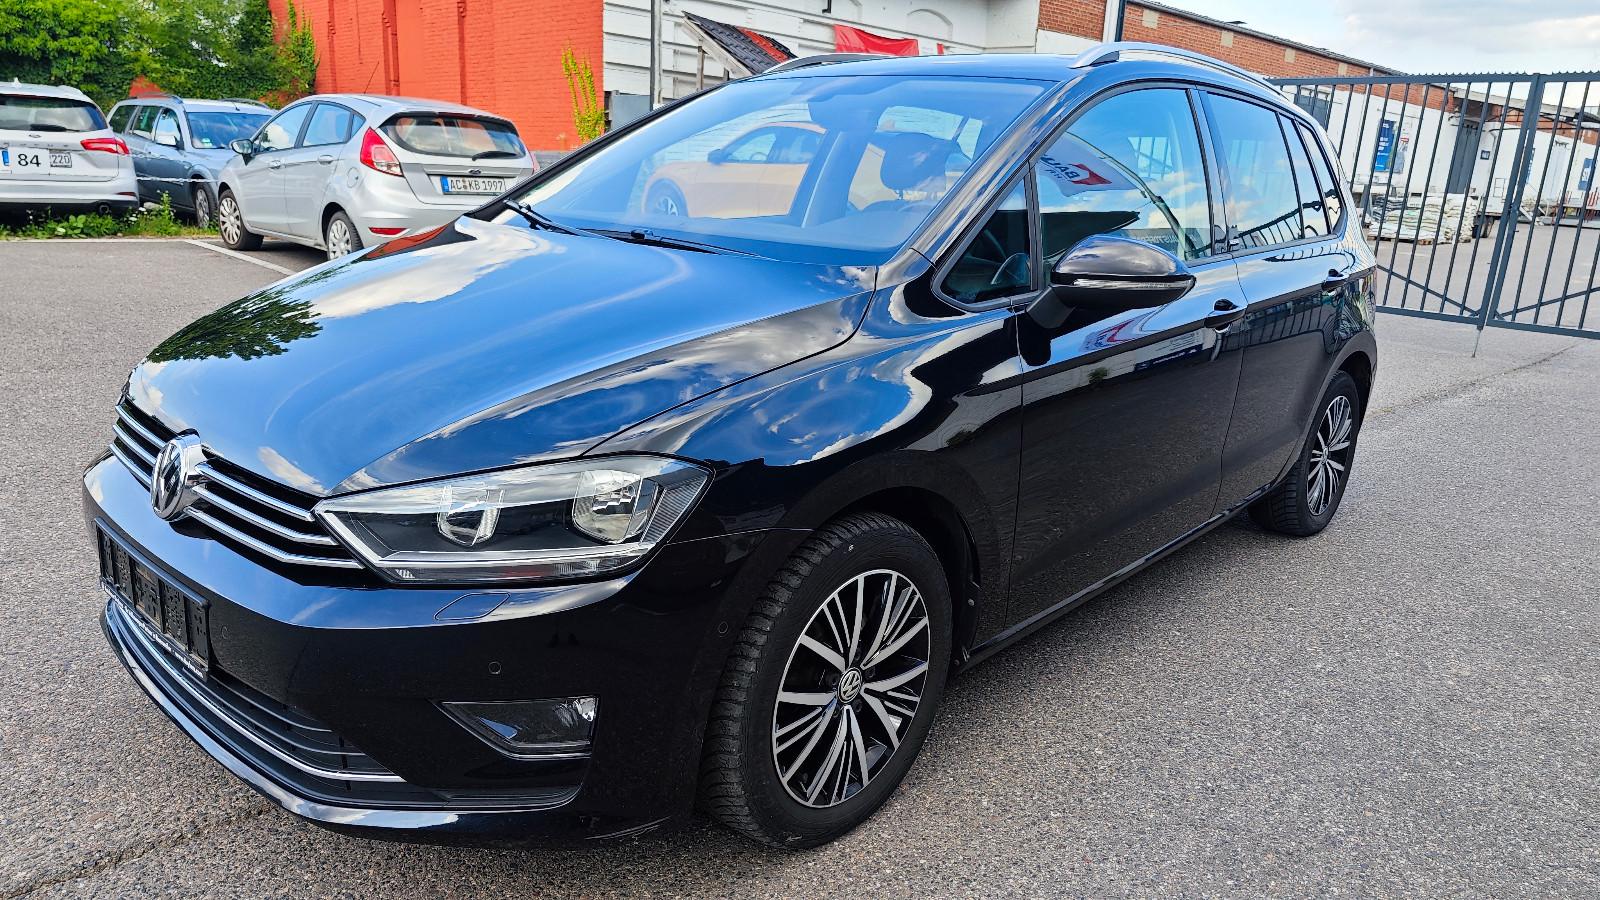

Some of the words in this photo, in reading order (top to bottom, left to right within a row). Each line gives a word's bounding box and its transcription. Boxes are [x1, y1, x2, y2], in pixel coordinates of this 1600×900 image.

[17, 153, 41, 167] 84
[450, 179, 462, 190] AC
[468, 180, 481, 191] KB
[481, 180, 503, 191] 1997
[839, 668, 862, 702] VW
